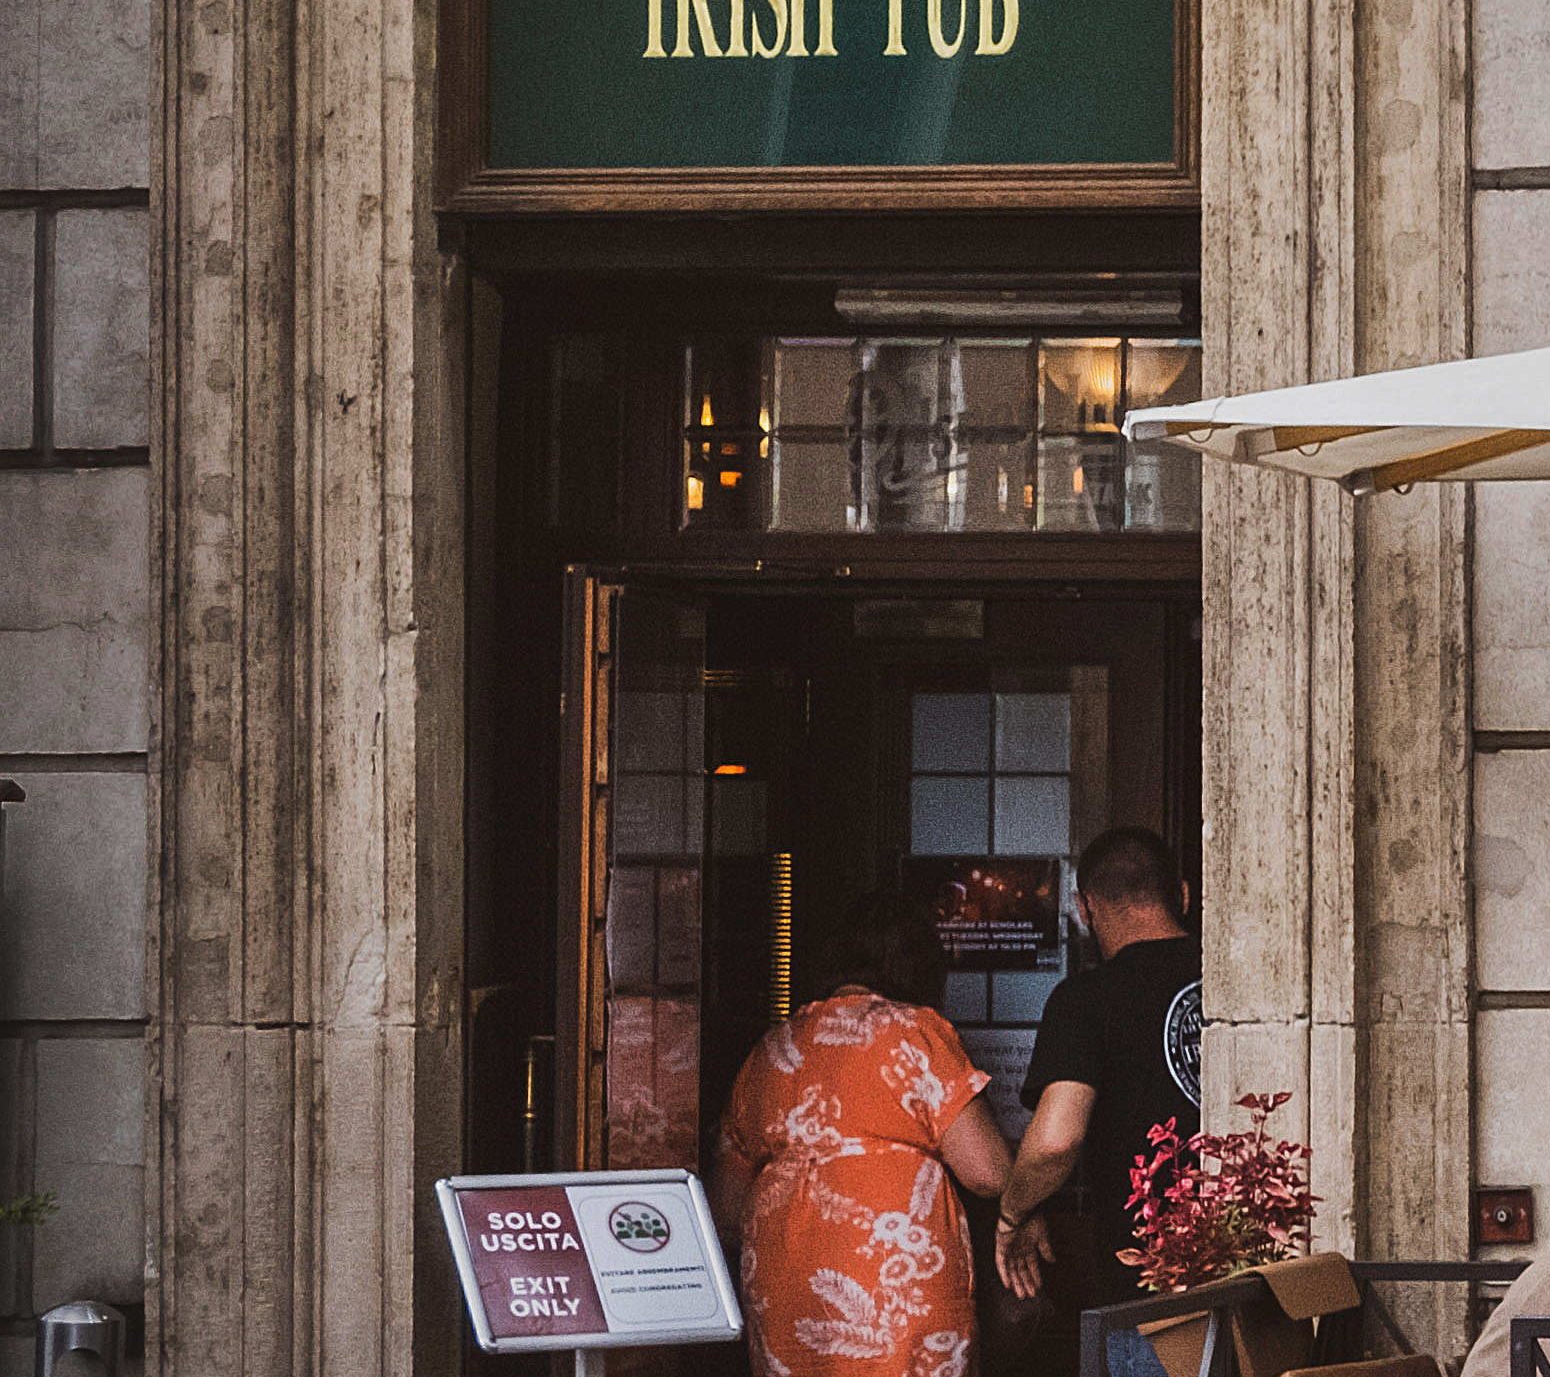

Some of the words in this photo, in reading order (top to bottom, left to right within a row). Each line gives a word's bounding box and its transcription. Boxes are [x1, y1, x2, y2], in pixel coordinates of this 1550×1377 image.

[487, 1211, 562, 1231] SOLO
[480, 1232, 579, 1252] USCITA
[510, 1275, 570, 1296] EXIT
[509, 1297, 581, 1319] ONLY
